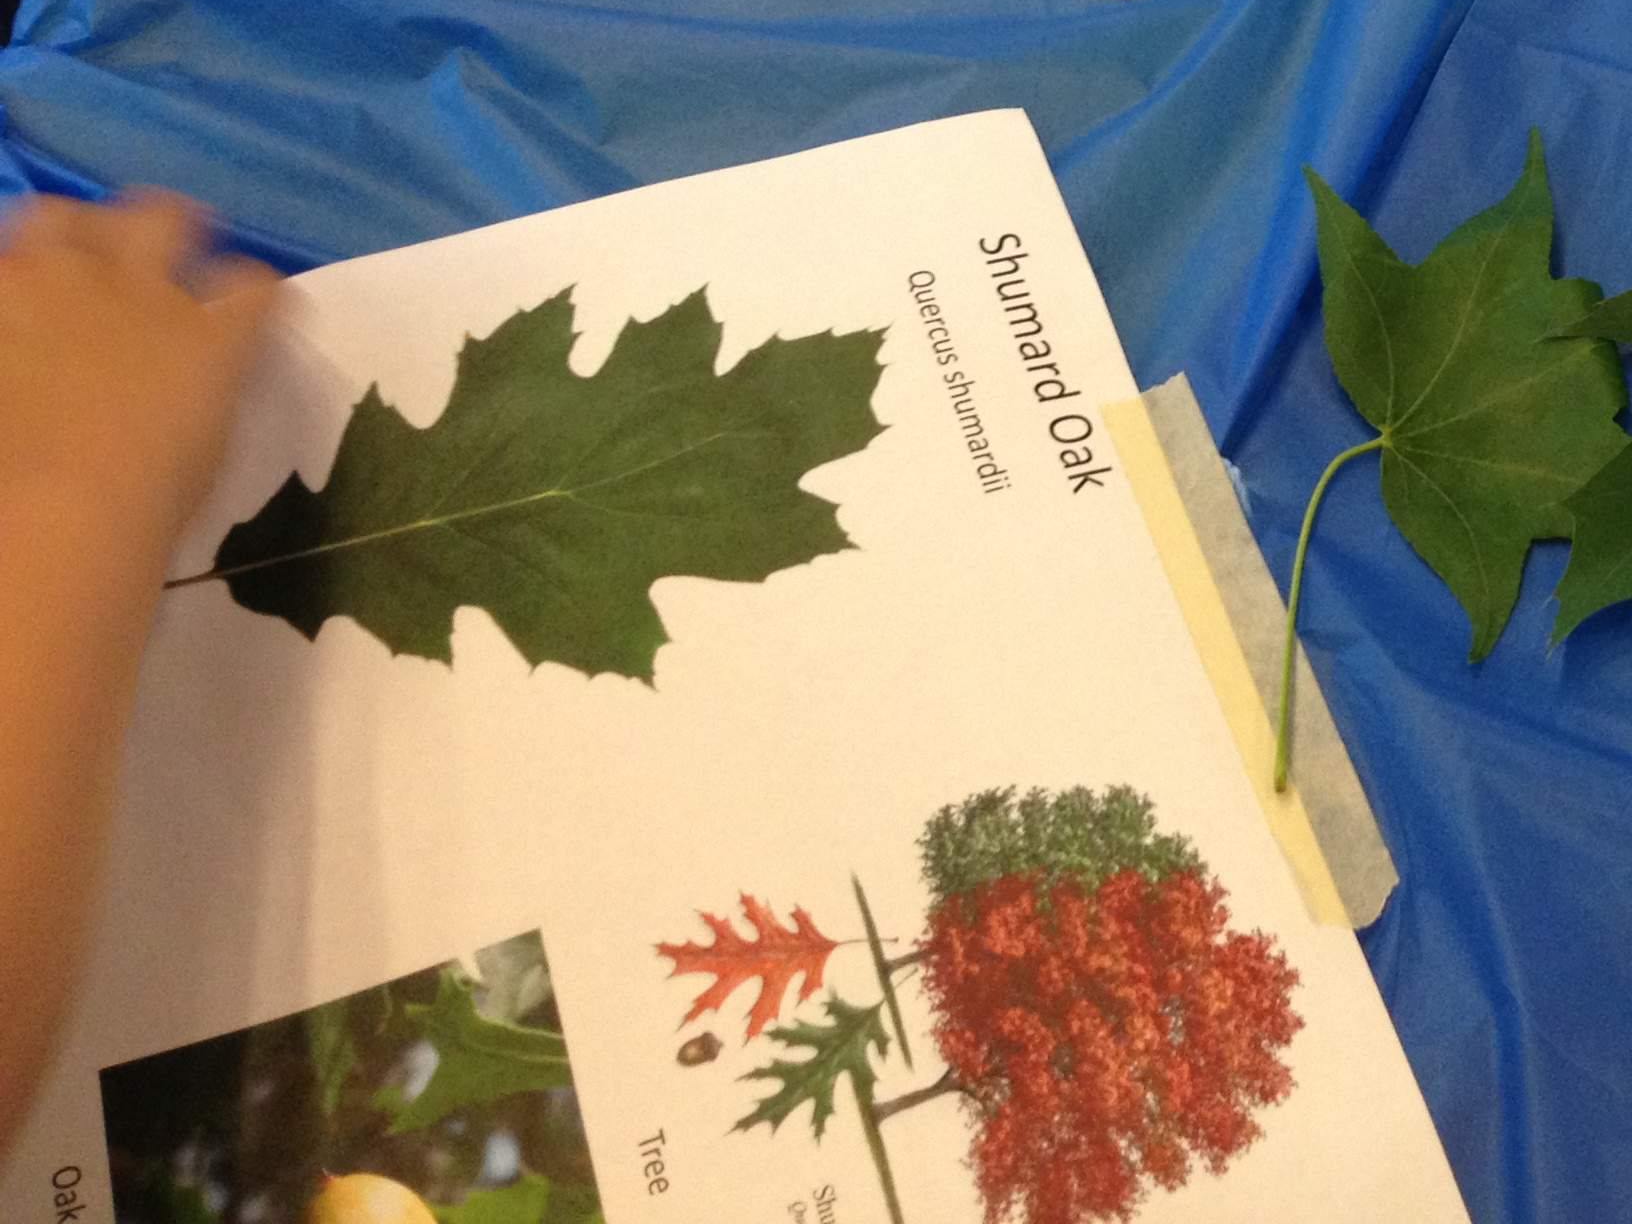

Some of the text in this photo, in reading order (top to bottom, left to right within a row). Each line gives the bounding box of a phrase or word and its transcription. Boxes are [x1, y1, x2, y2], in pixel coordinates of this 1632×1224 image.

[907, 269, 1013, 496] Quercus shumardii
[978, 232, 1113, 495] Shumard Oak
[52, 1165, 87, 1224] Oak
[637, 1127, 671, 1198] Tree
[812, 1183, 836, 1224] Shu
